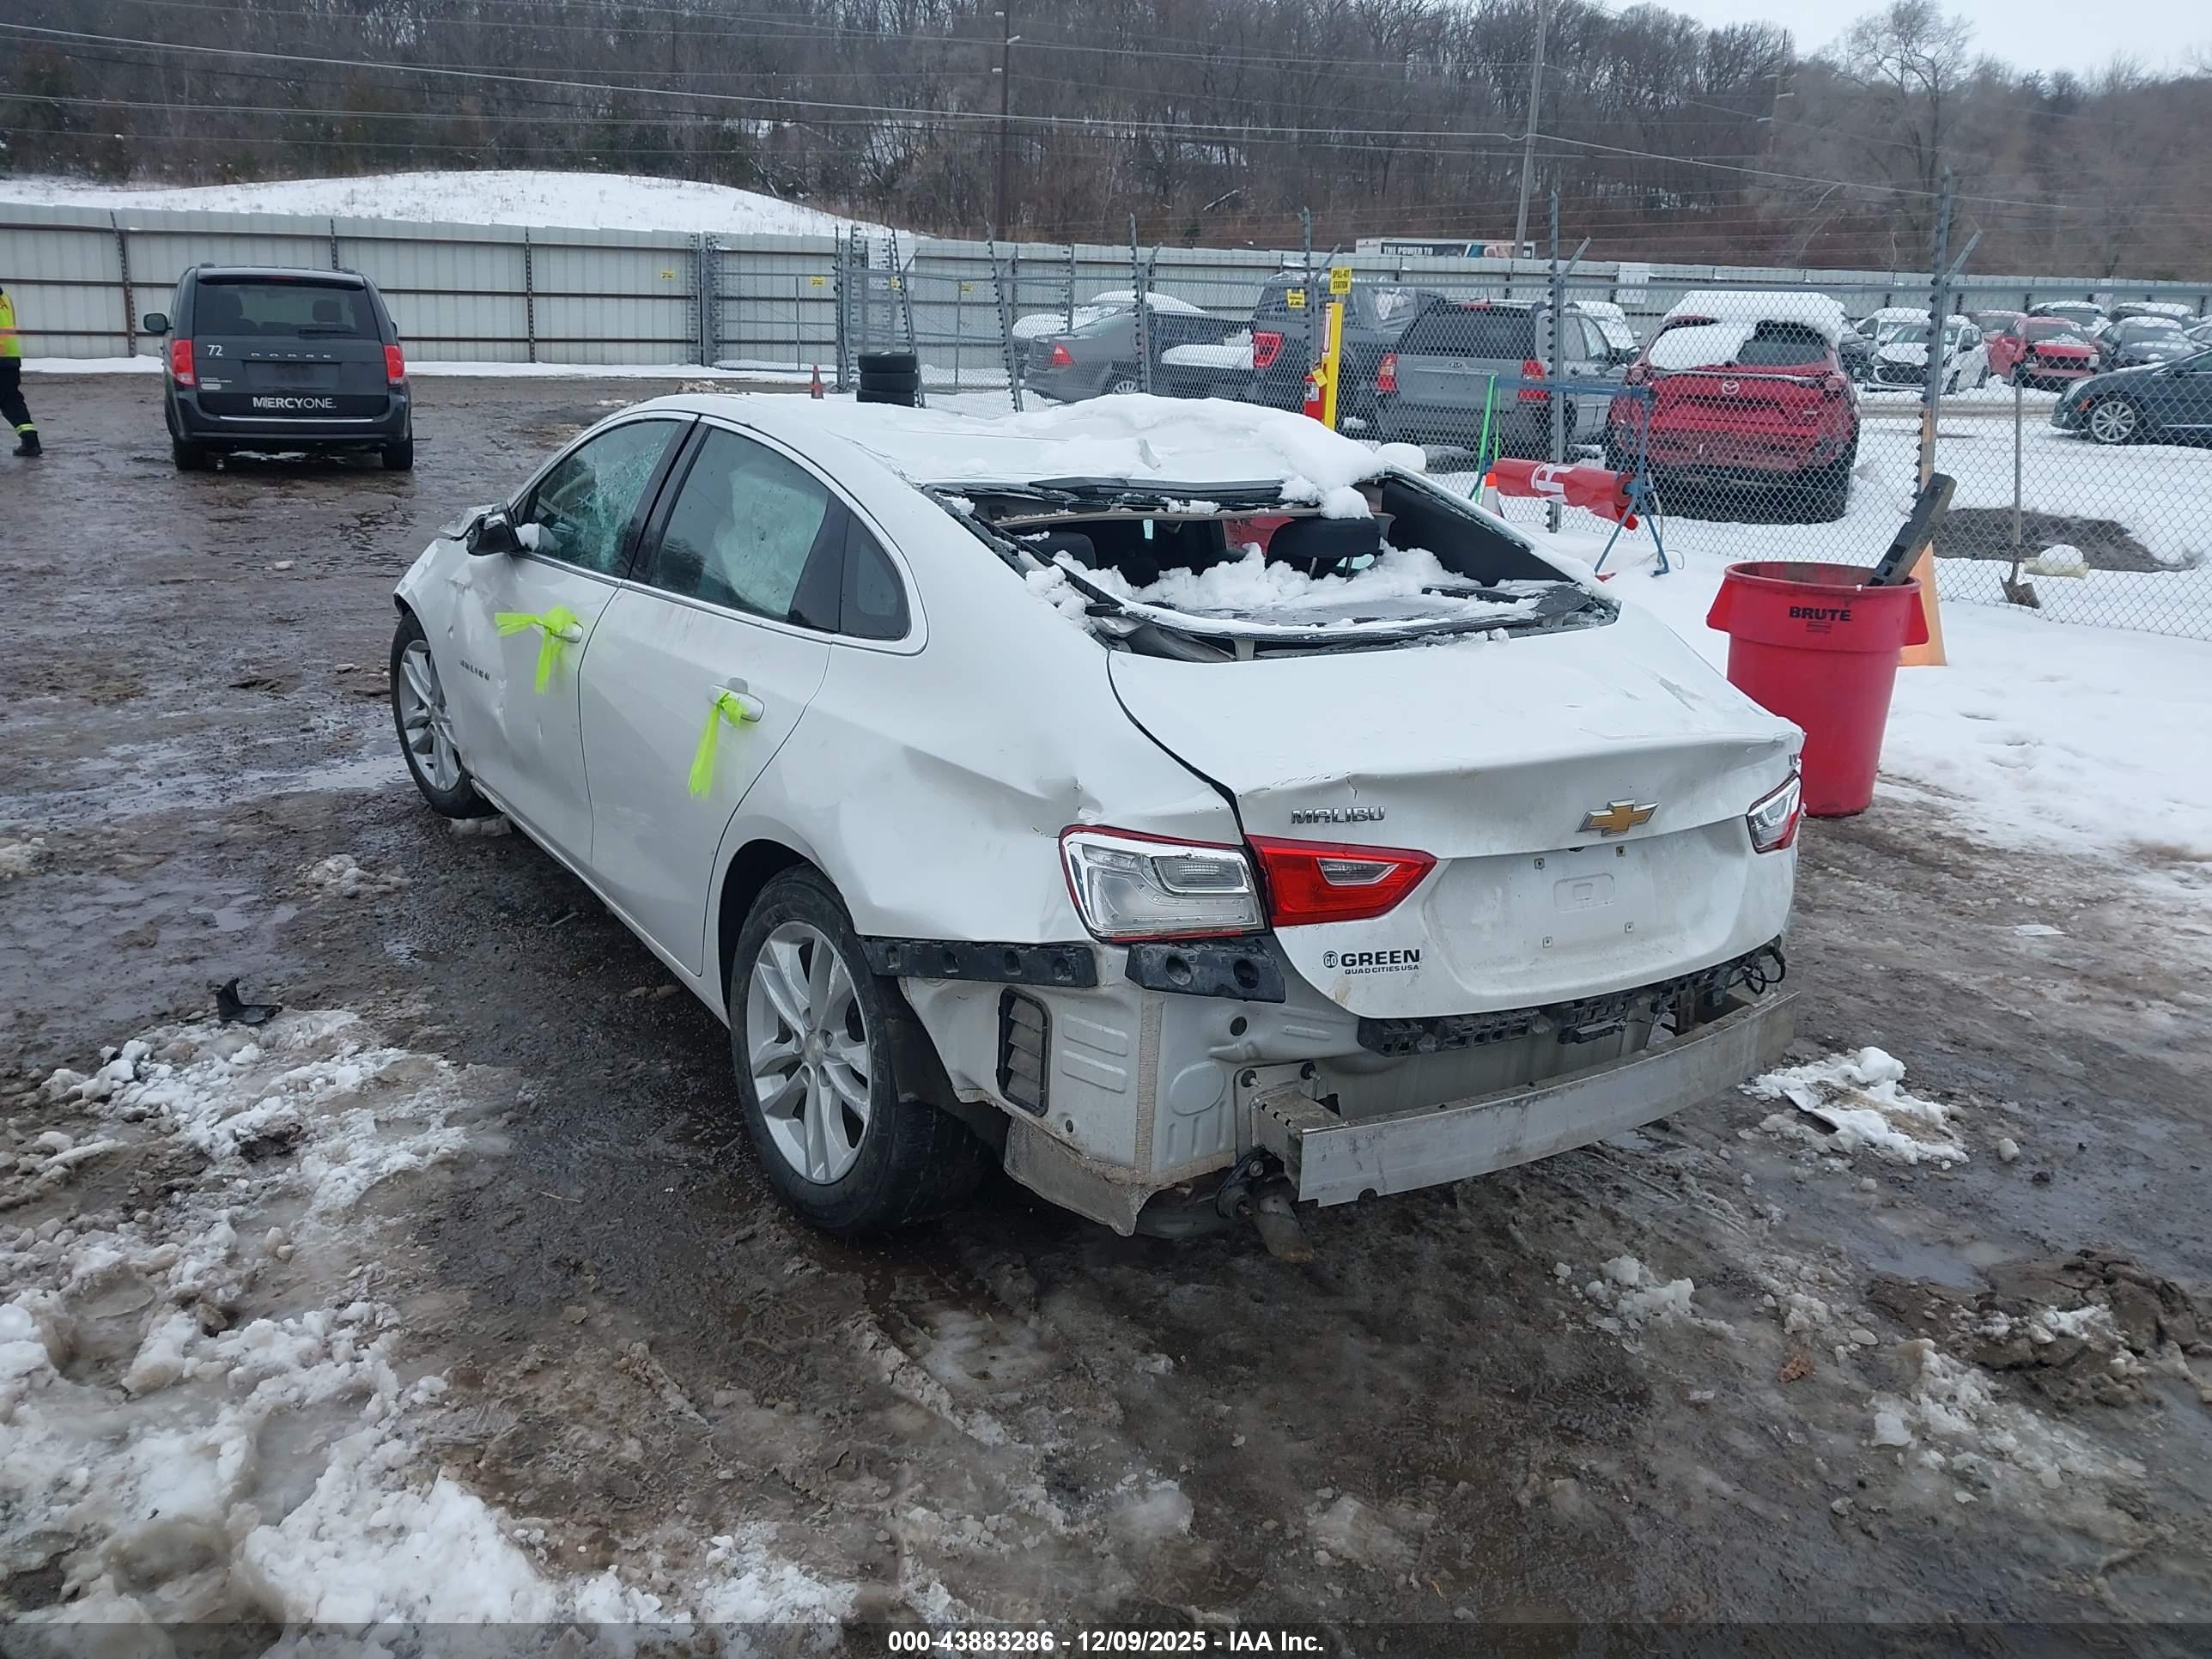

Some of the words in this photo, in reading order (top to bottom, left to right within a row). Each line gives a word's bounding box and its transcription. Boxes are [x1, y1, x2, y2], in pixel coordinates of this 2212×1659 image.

[1383, 246, 1396, 256] THE
[1397, 246, 1422, 256] POWER
[1422, 246, 1433, 256] TO
[1333, 281, 1348, 289] STATION
[207, 344, 223, 356] 72
[1789, 605, 1852, 622] BRUTE
[1291, 805, 1386, 824] MALIBU
[1340, 949, 1421, 968] GREEN
